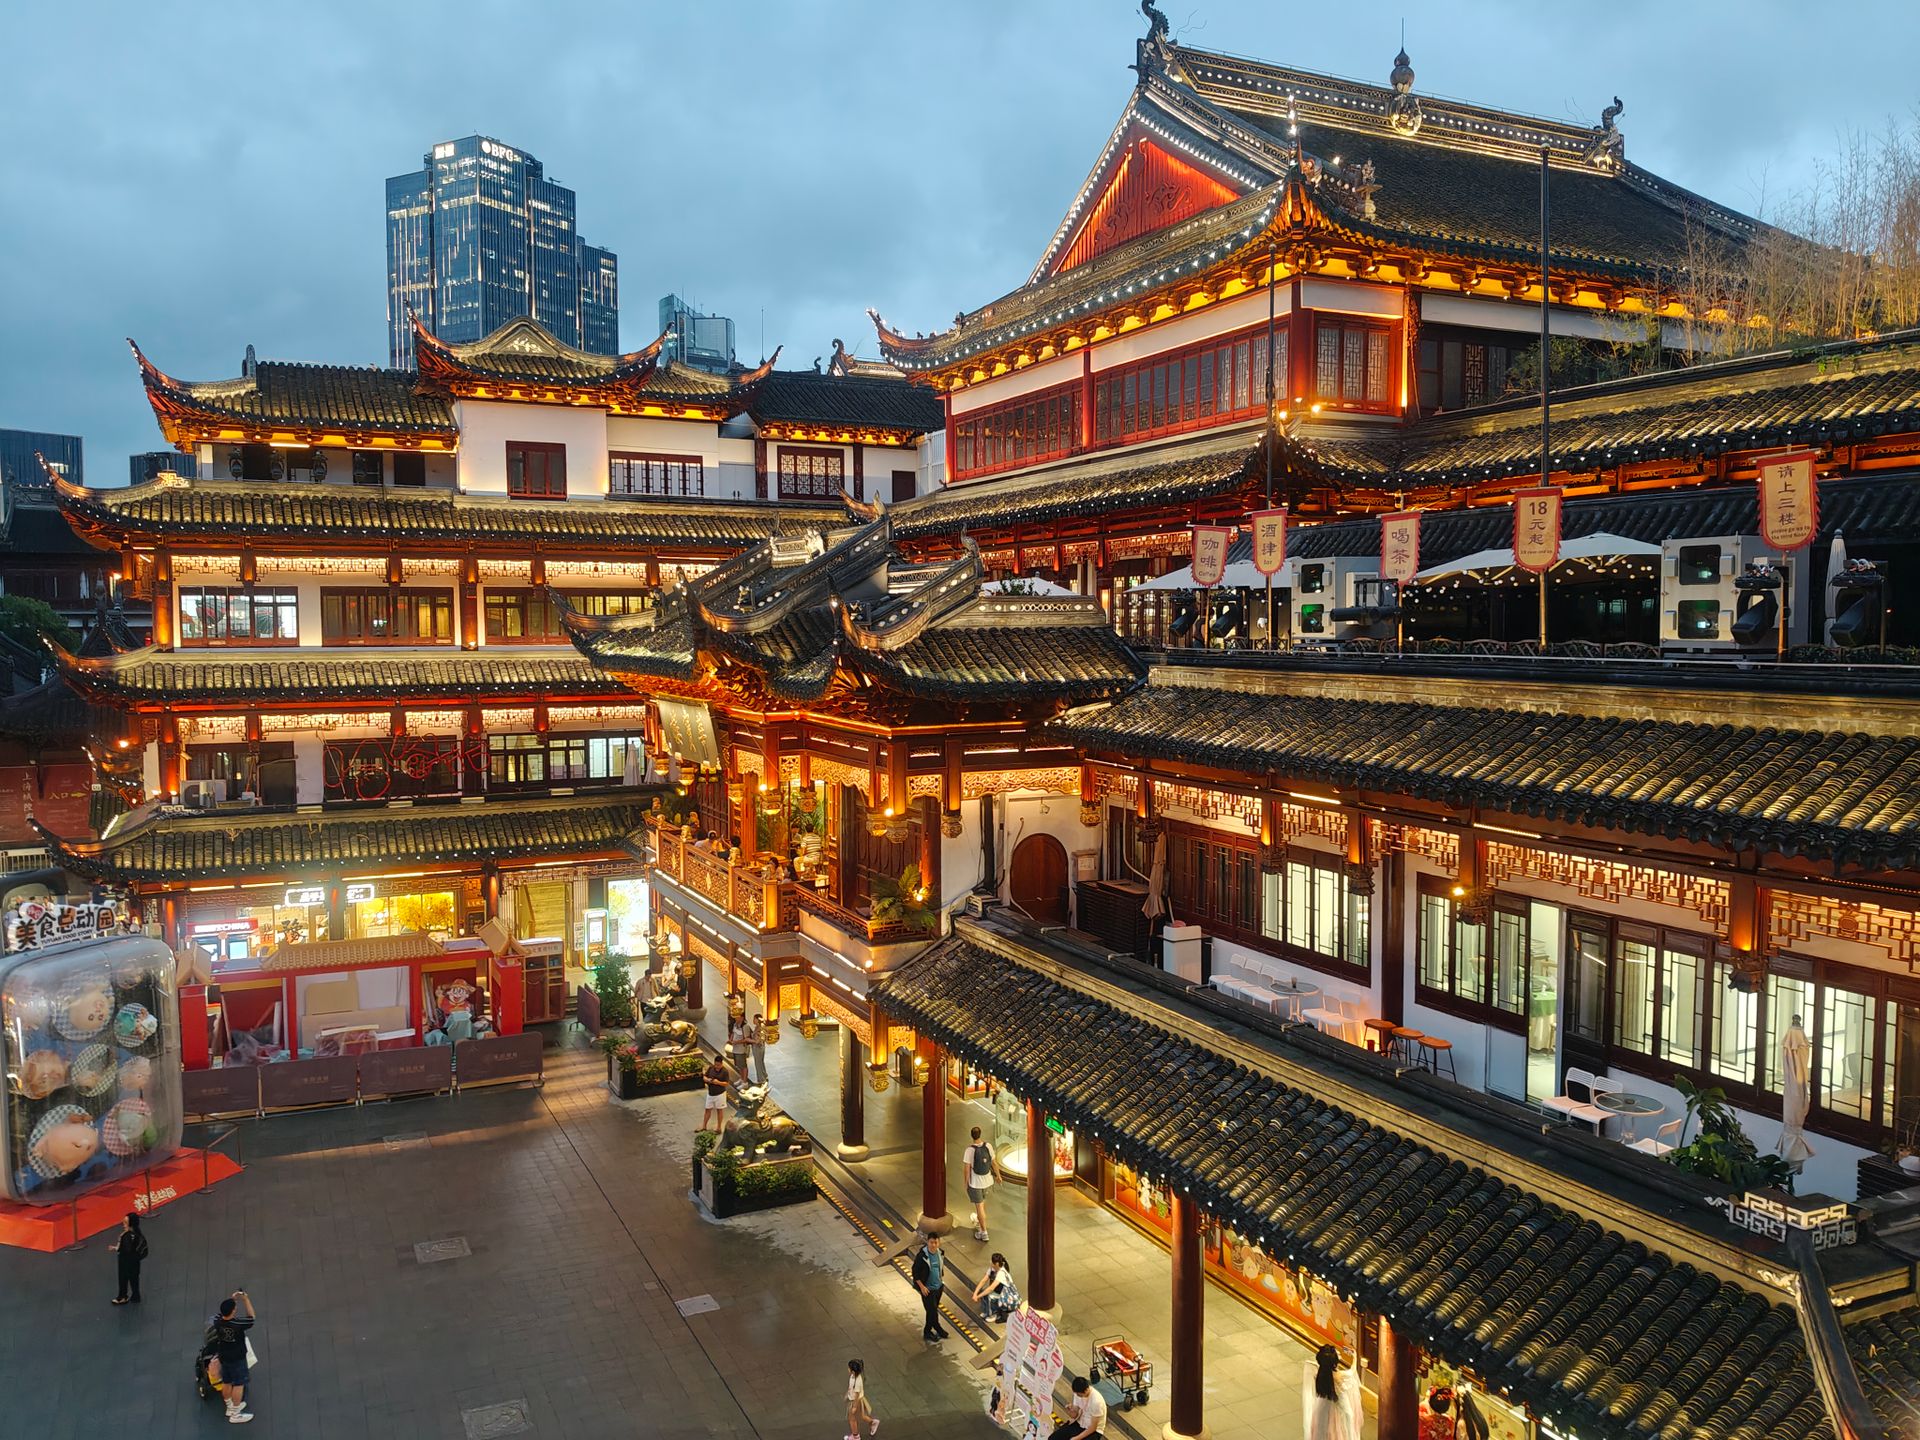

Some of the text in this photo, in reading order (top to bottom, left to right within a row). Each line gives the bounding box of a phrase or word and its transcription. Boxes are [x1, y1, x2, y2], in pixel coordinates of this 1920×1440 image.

[1778, 465, 1796, 526] 请上三楼
[1261, 523, 1277, 556] 酒肆
[1528, 501, 1547, 546] 18元起
[1201, 538, 1219, 568] 咖啡
[1391, 528, 1410, 564] 喝茶
[49, 792, 69, 800] 入口
